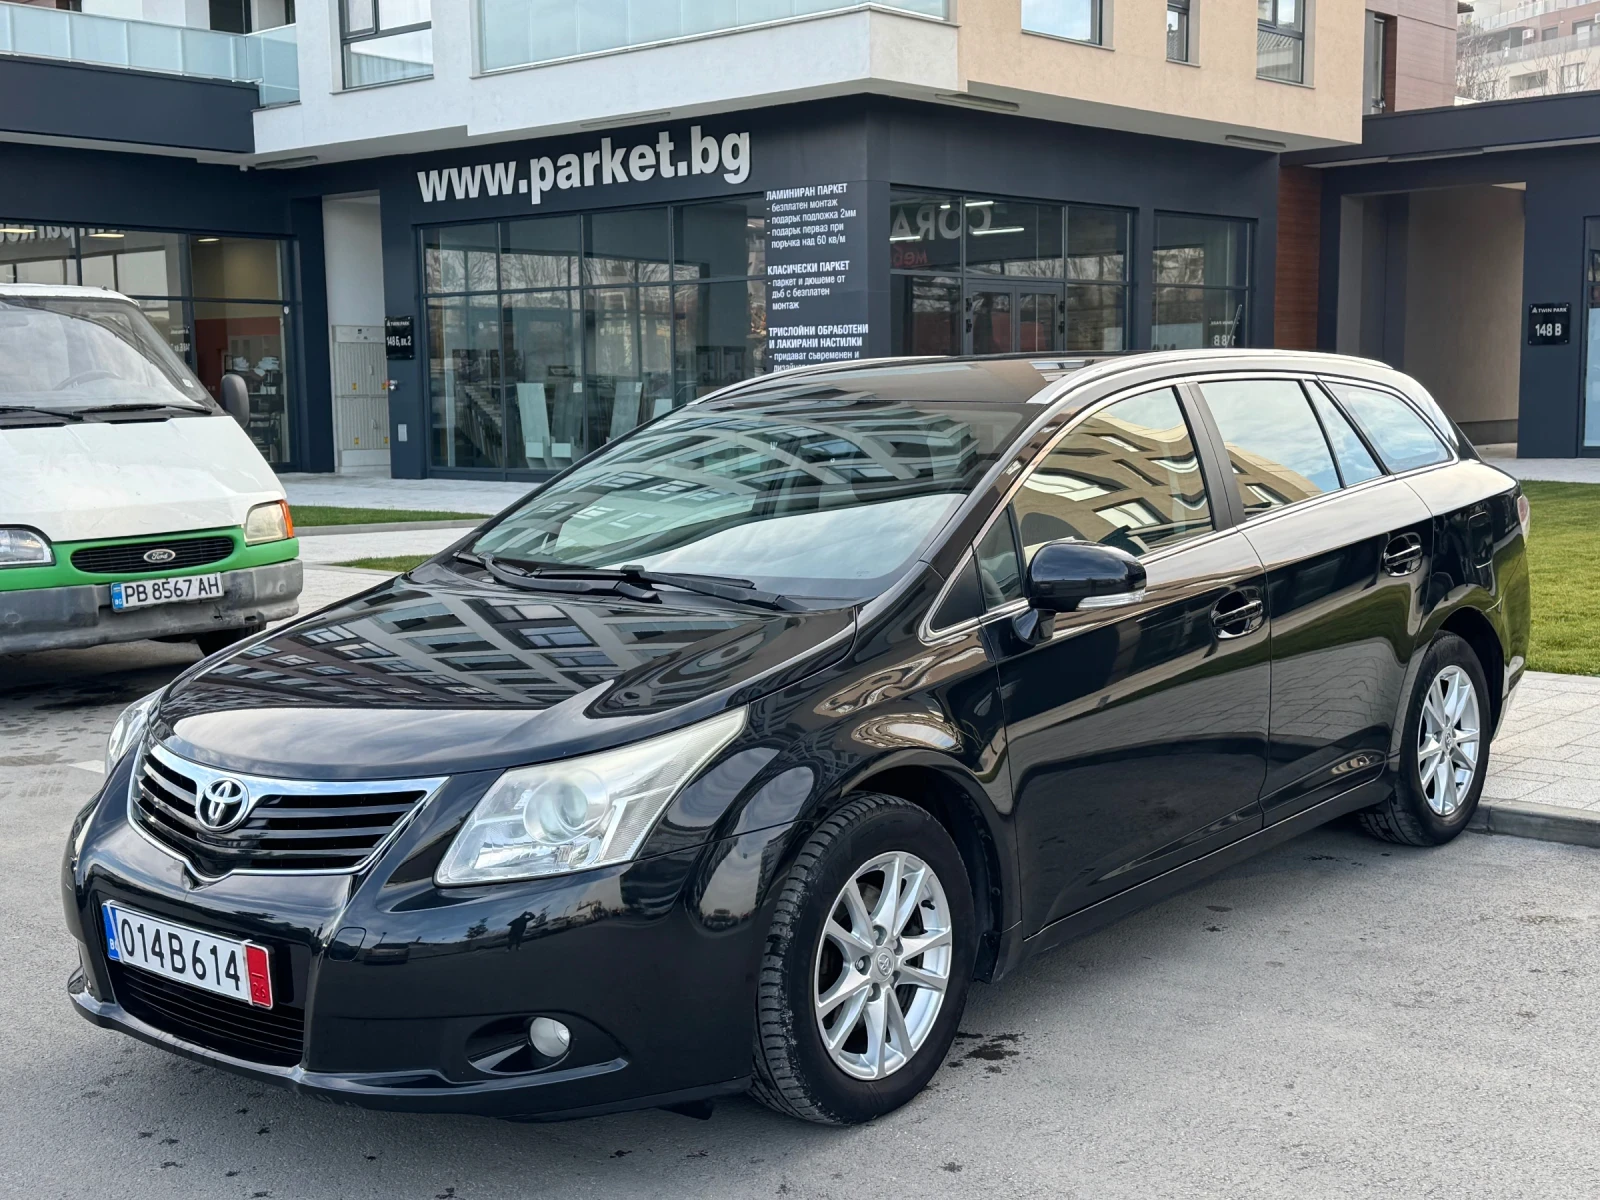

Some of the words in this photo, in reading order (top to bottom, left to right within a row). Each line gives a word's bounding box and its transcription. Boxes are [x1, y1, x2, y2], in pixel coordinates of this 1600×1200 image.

[417, 125, 751, 205] www.parket.bg
[766, 187, 815, 201] ЛАМИНИРАН
[817, 183, 848, 195] ПАРКЕТ
[771, 201, 808, 212] безплатен
[810, 198, 838, 209] монтаж
[802, 211, 838, 221] подложка
[840, 208, 856, 219] 2мм
[802, 224, 828, 235] перваз
[830, 223, 844, 233] при
[802, 237, 815, 247] над
[816, 235, 826, 245] 60
[767, 262, 818, 275] КЛАСИЧЕСКИ
[820, 260, 850, 272] ПАРКЕТ
[772, 278, 796, 287] паркет
[804, 275, 835, 286] дюшеме
[836, 275, 846, 283] от
[792, 287, 830, 297] безплатен
[772, 301, 800, 310] монтаж
[768, 325, 815, 337] ТРИСЛОЙНИ
[817, 323, 869, 335] ОБРАБОТЕНИ
[1535, 323, 1553, 337] 148
[768, 340, 775, 349] И
[776, 338, 818, 349] ЛАКИРАНИ
[820, 336, 863, 347] НАСТИЛКИ
[773, 352, 807, 362] придават
[151, 551, 168, 560] Ford
[124, 583, 148, 605] PB
[152, 579, 192, 600] 8567
[198, 577, 220, 596] AH
[121, 918, 241, 992] 014B614
